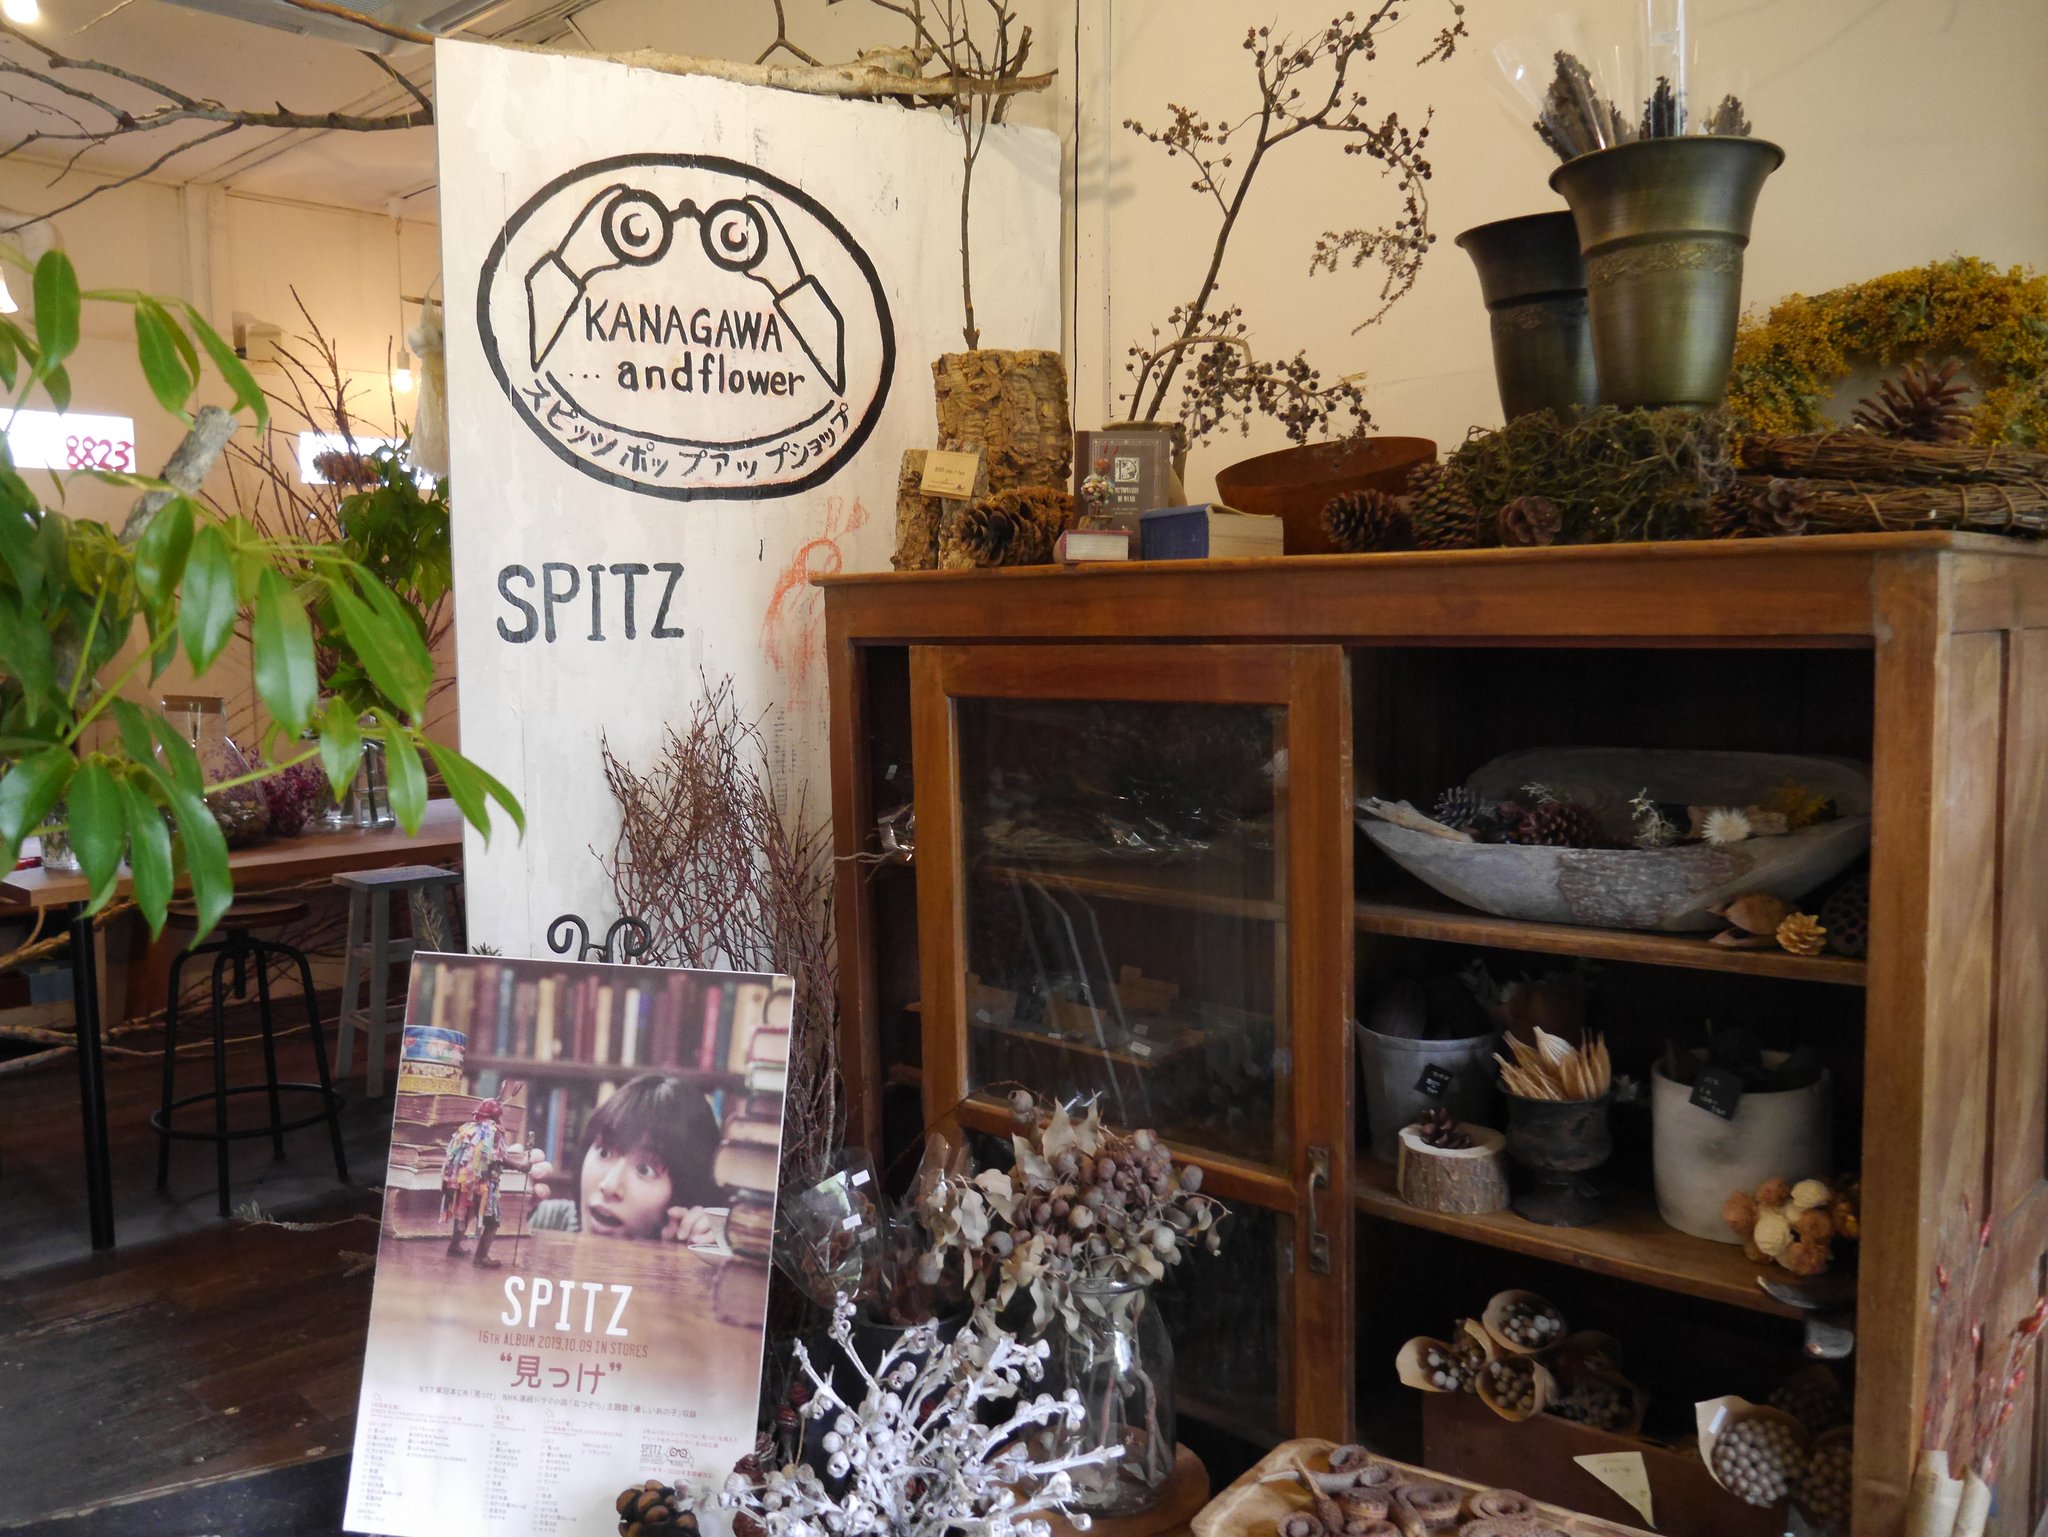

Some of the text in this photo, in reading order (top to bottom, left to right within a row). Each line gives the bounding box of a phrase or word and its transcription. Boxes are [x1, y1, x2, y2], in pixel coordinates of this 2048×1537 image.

[585, 297, 783, 353] KANAGAWA
[66, 435, 134, 472] 8823
[496, 562, 685, 644] SPITZ
[501, 1275, 633, 1337] SPITZ
[503, 1333, 535, 1348] ALBUM
[595, 1341, 607, 1355] IN
[610, 1343, 649, 1358] STORES
